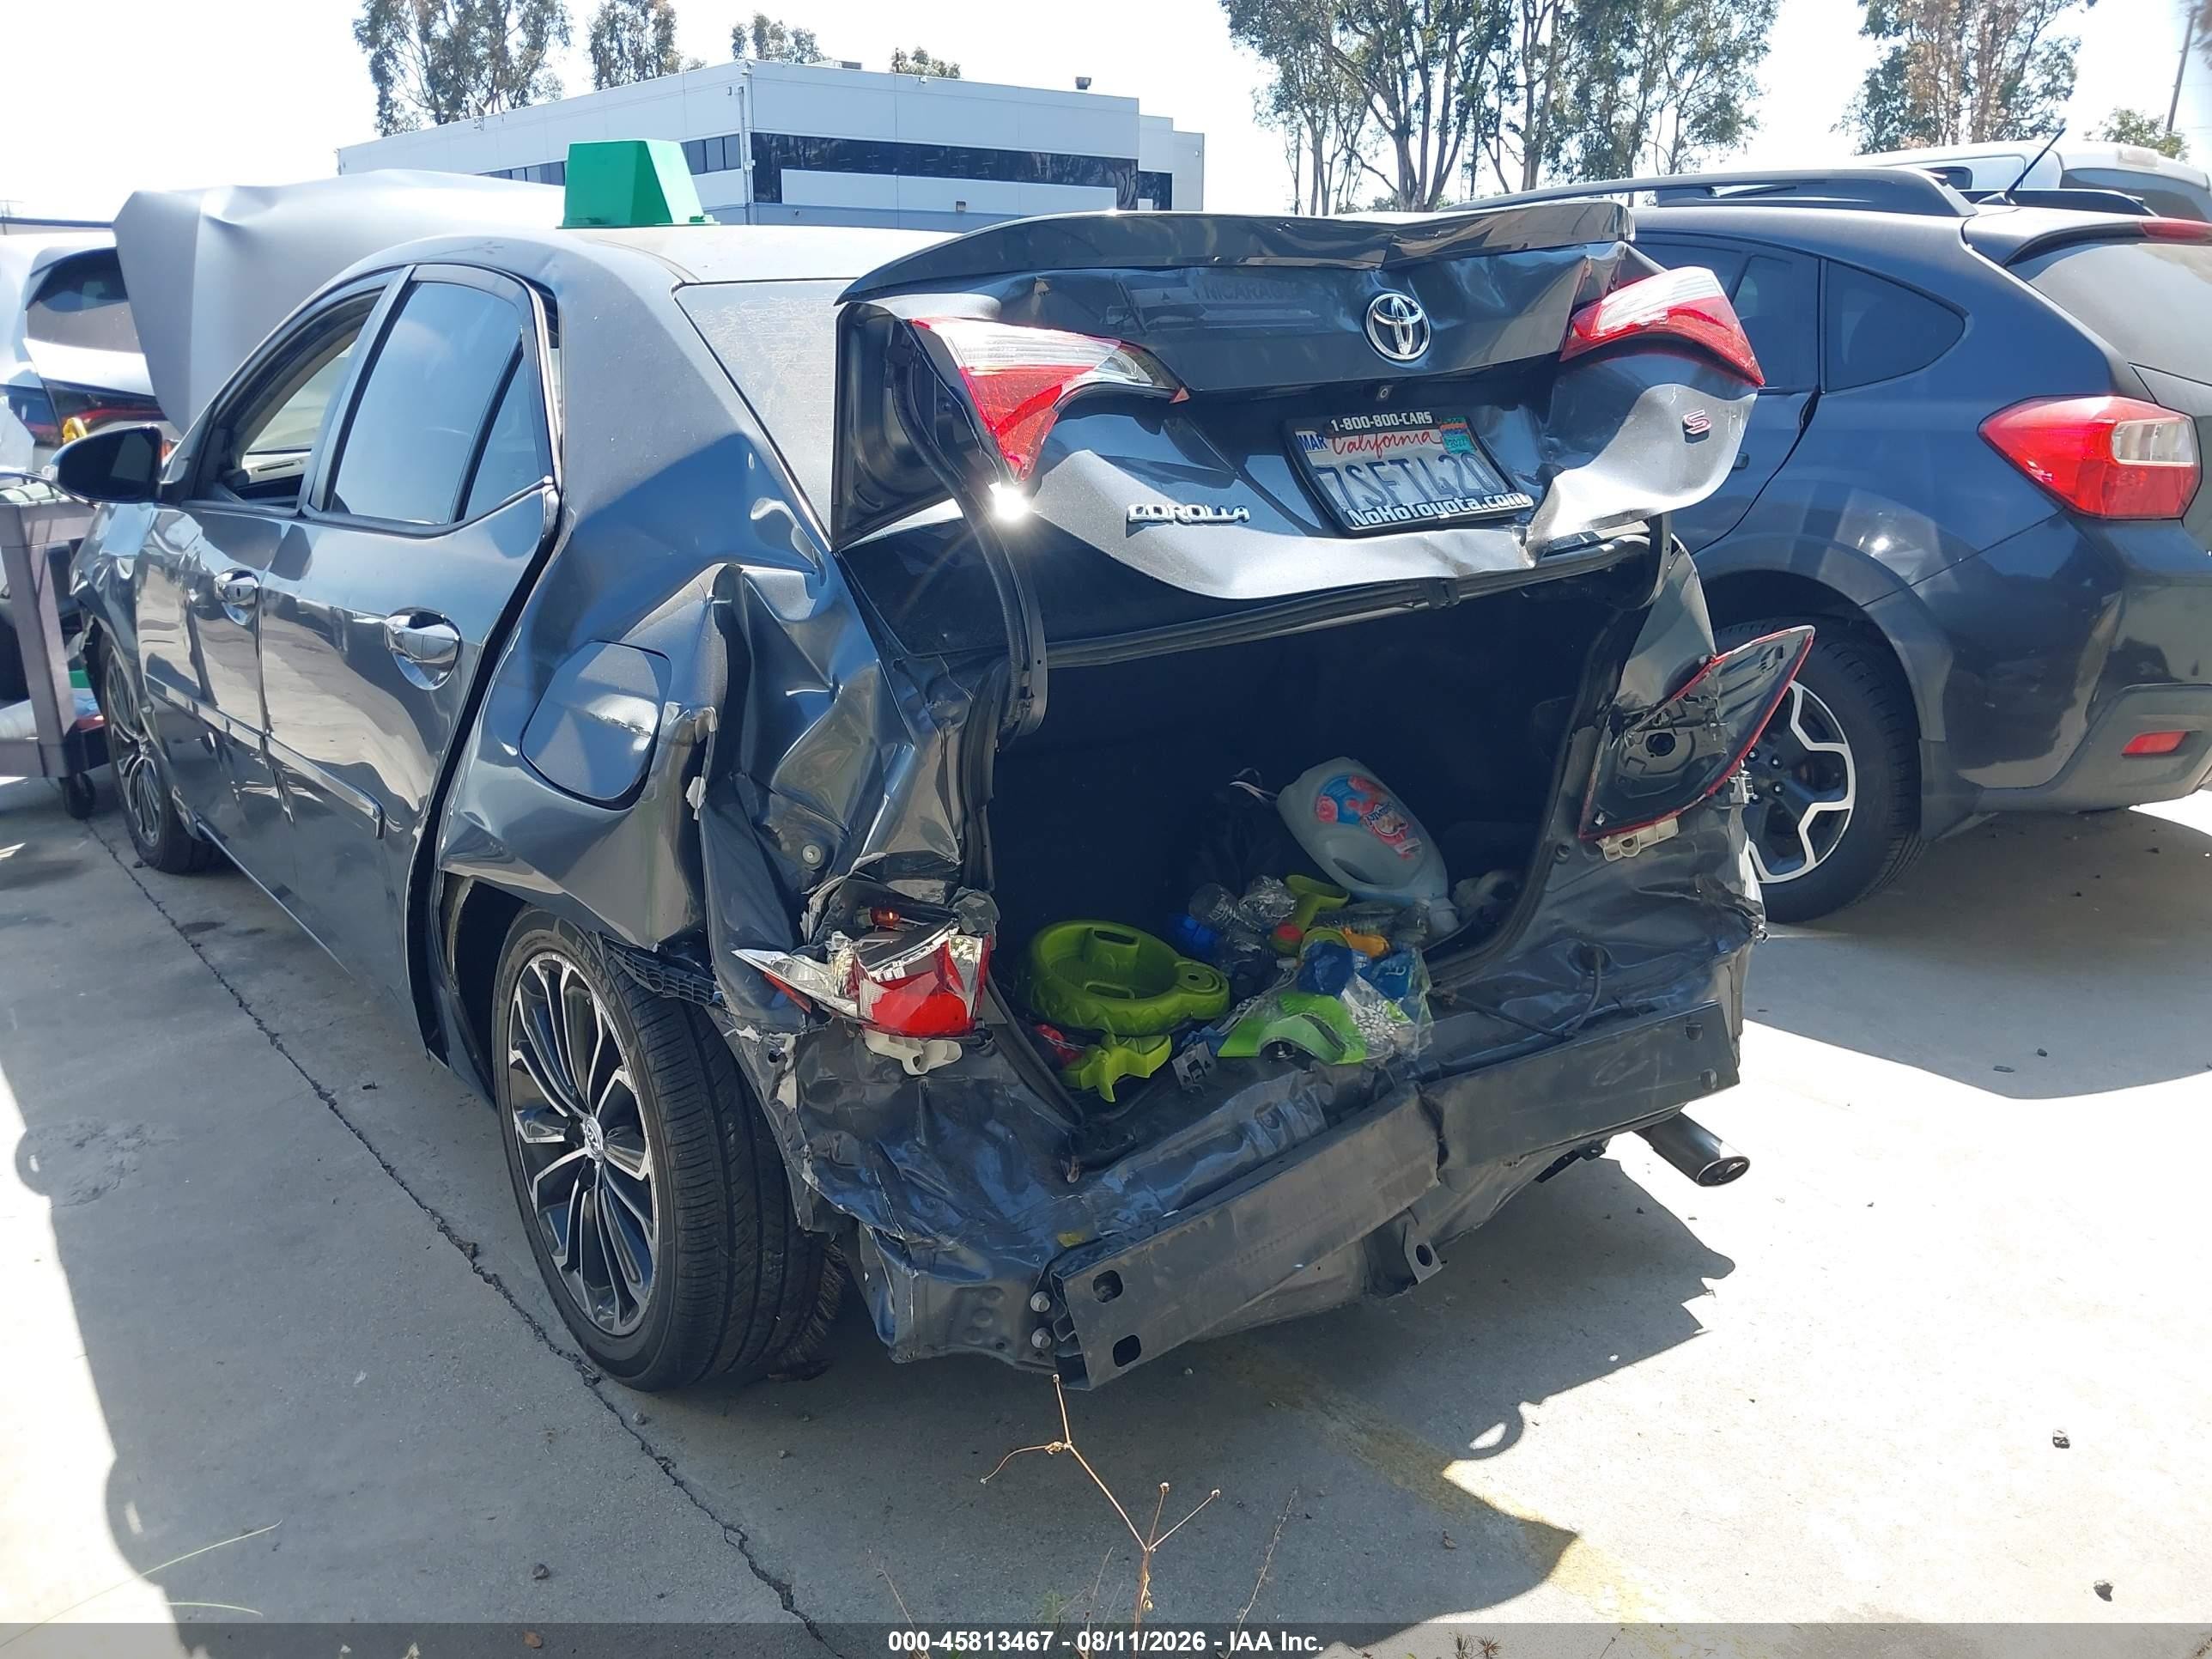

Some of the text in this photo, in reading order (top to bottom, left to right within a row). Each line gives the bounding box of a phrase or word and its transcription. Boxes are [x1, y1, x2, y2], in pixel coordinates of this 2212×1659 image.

[1331, 411, 1433, 432] 1-800-800-CARS
[1682, 409, 1711, 434] S
[1298, 434, 1328, 452] MAR
[1332, 430, 1443, 459] California
[1127, 504, 1250, 523] COROLLA
[1347, 492, 1531, 526] NoHoToyota.com
